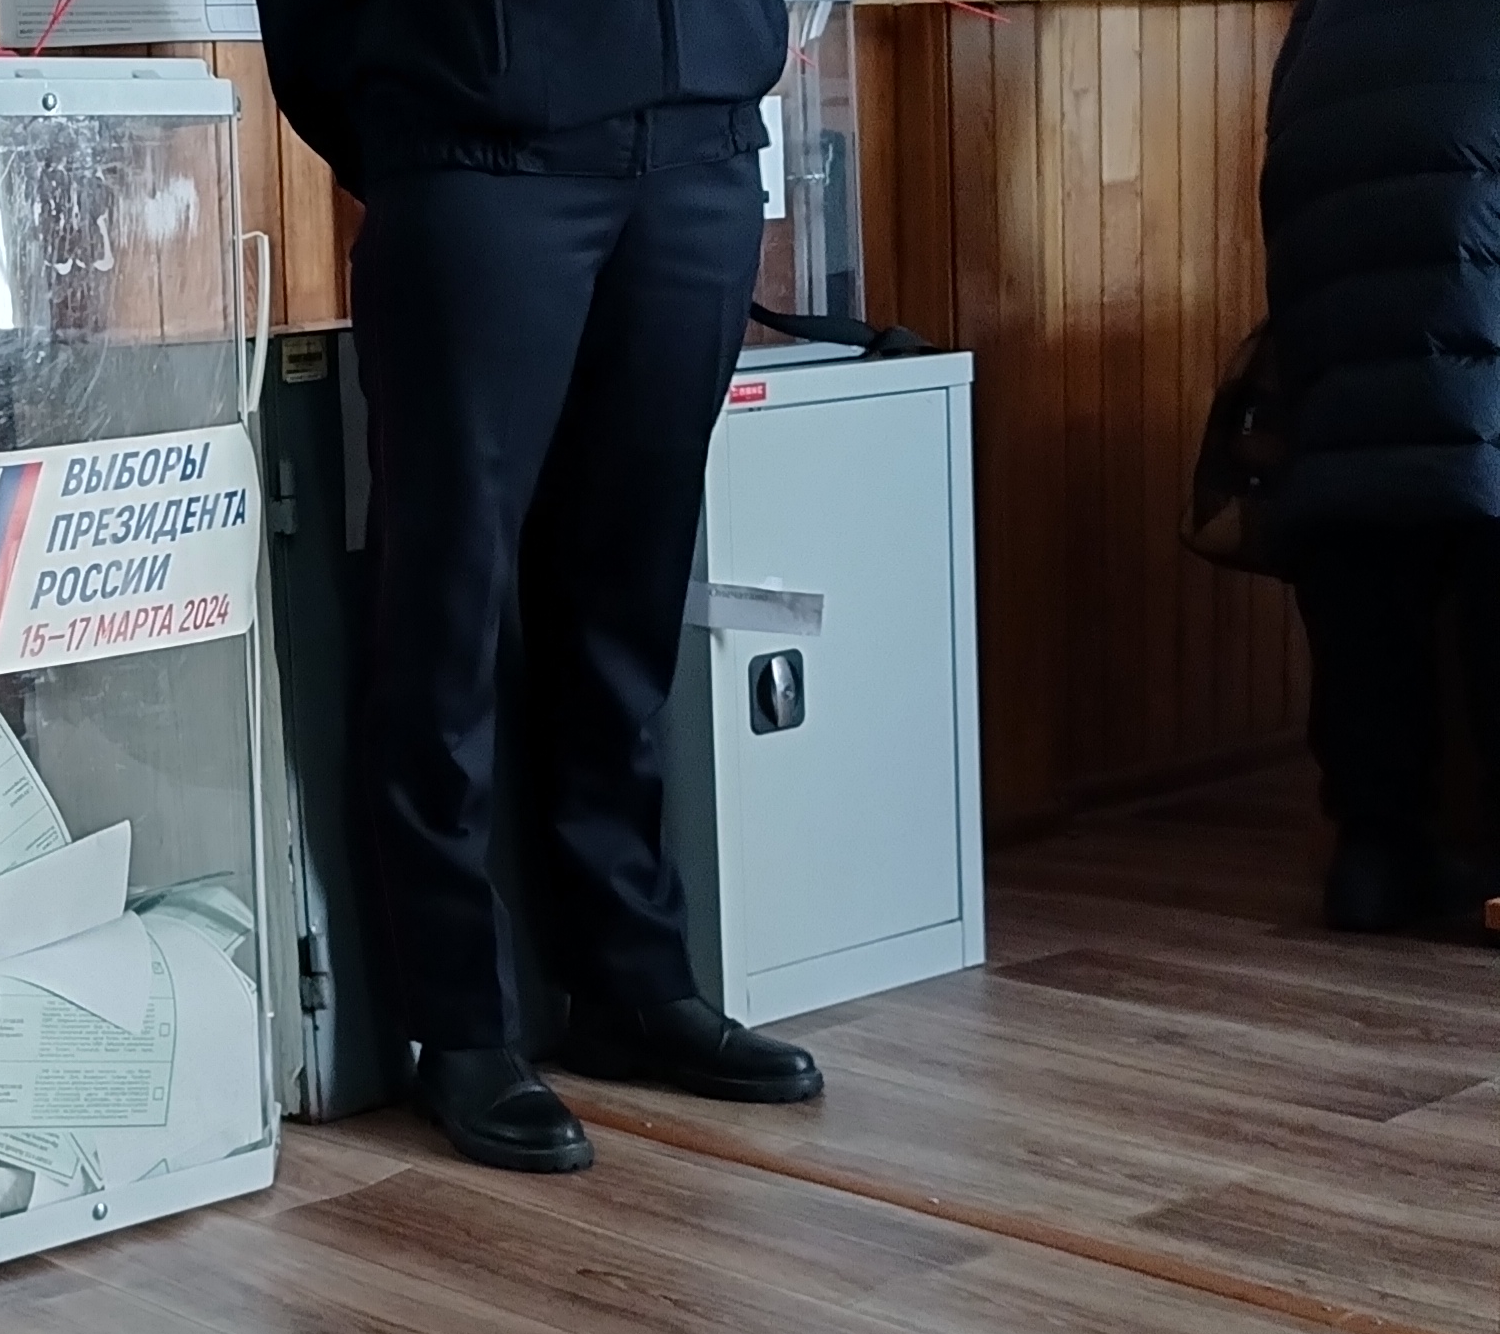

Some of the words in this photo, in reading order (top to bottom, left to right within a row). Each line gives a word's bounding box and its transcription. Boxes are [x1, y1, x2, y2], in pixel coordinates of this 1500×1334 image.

[60, 442, 211, 498] ВЫБОРЫ
[46, 488, 247, 554] ПРЕЗИДЕНТА
[30, 553, 173, 611] РОССИИ
[94, 607, 174, 646] МАРТА
[178, 593, 230, 635] 2024
